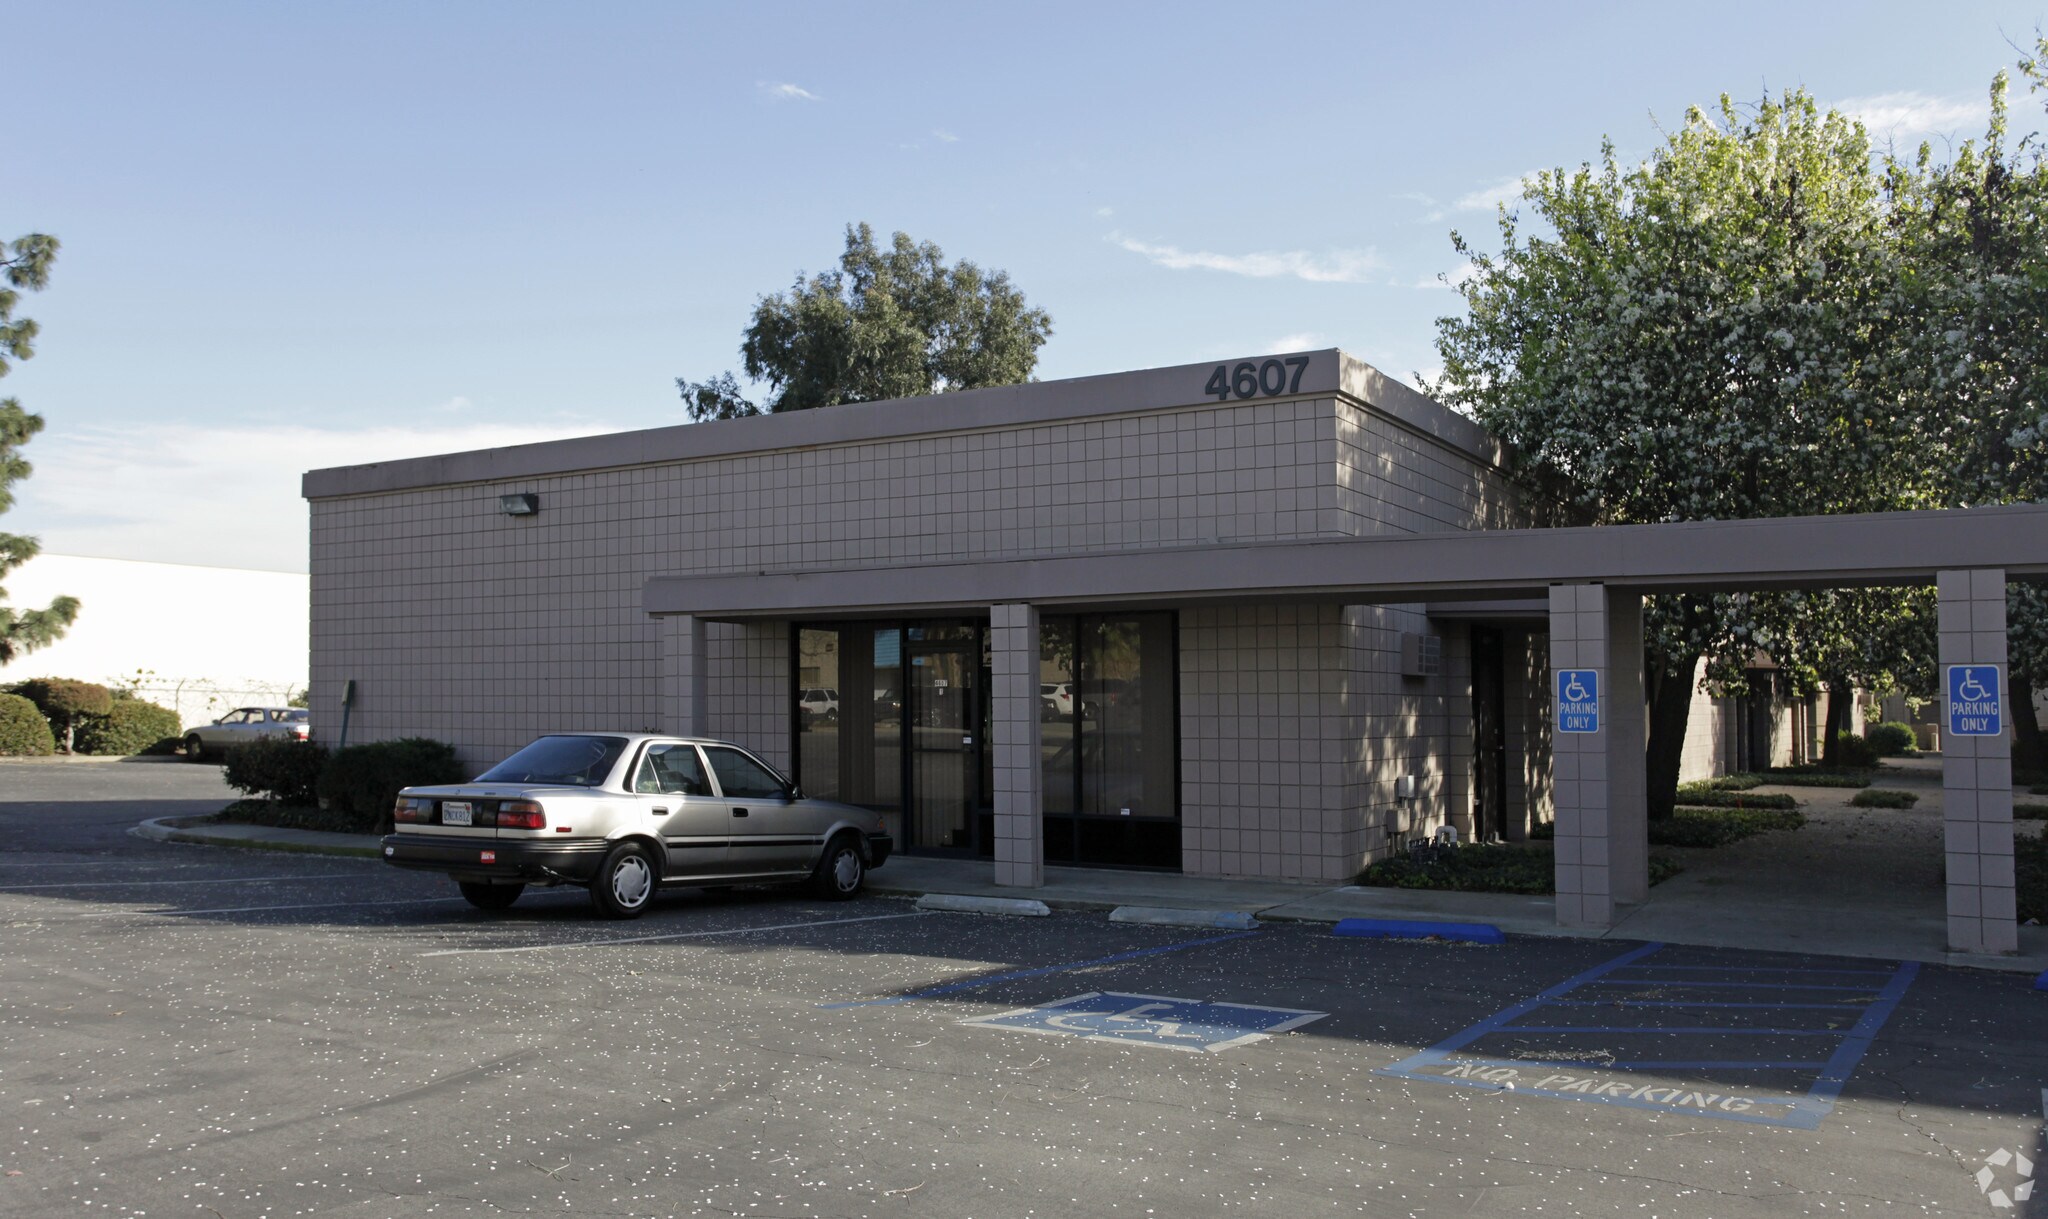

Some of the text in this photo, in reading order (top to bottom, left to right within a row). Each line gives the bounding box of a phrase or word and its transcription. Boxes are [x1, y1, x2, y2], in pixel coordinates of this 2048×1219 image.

[1205, 356, 1309, 400] 4607
[1560, 702, 1597, 714] PARKING
[1952, 702, 1998, 715] PARKING
[1567, 716, 1589, 728] ONLY
[1961, 717, 1988, 731] ONLY
[1443, 1064, 1754, 1111] NO PARKING
